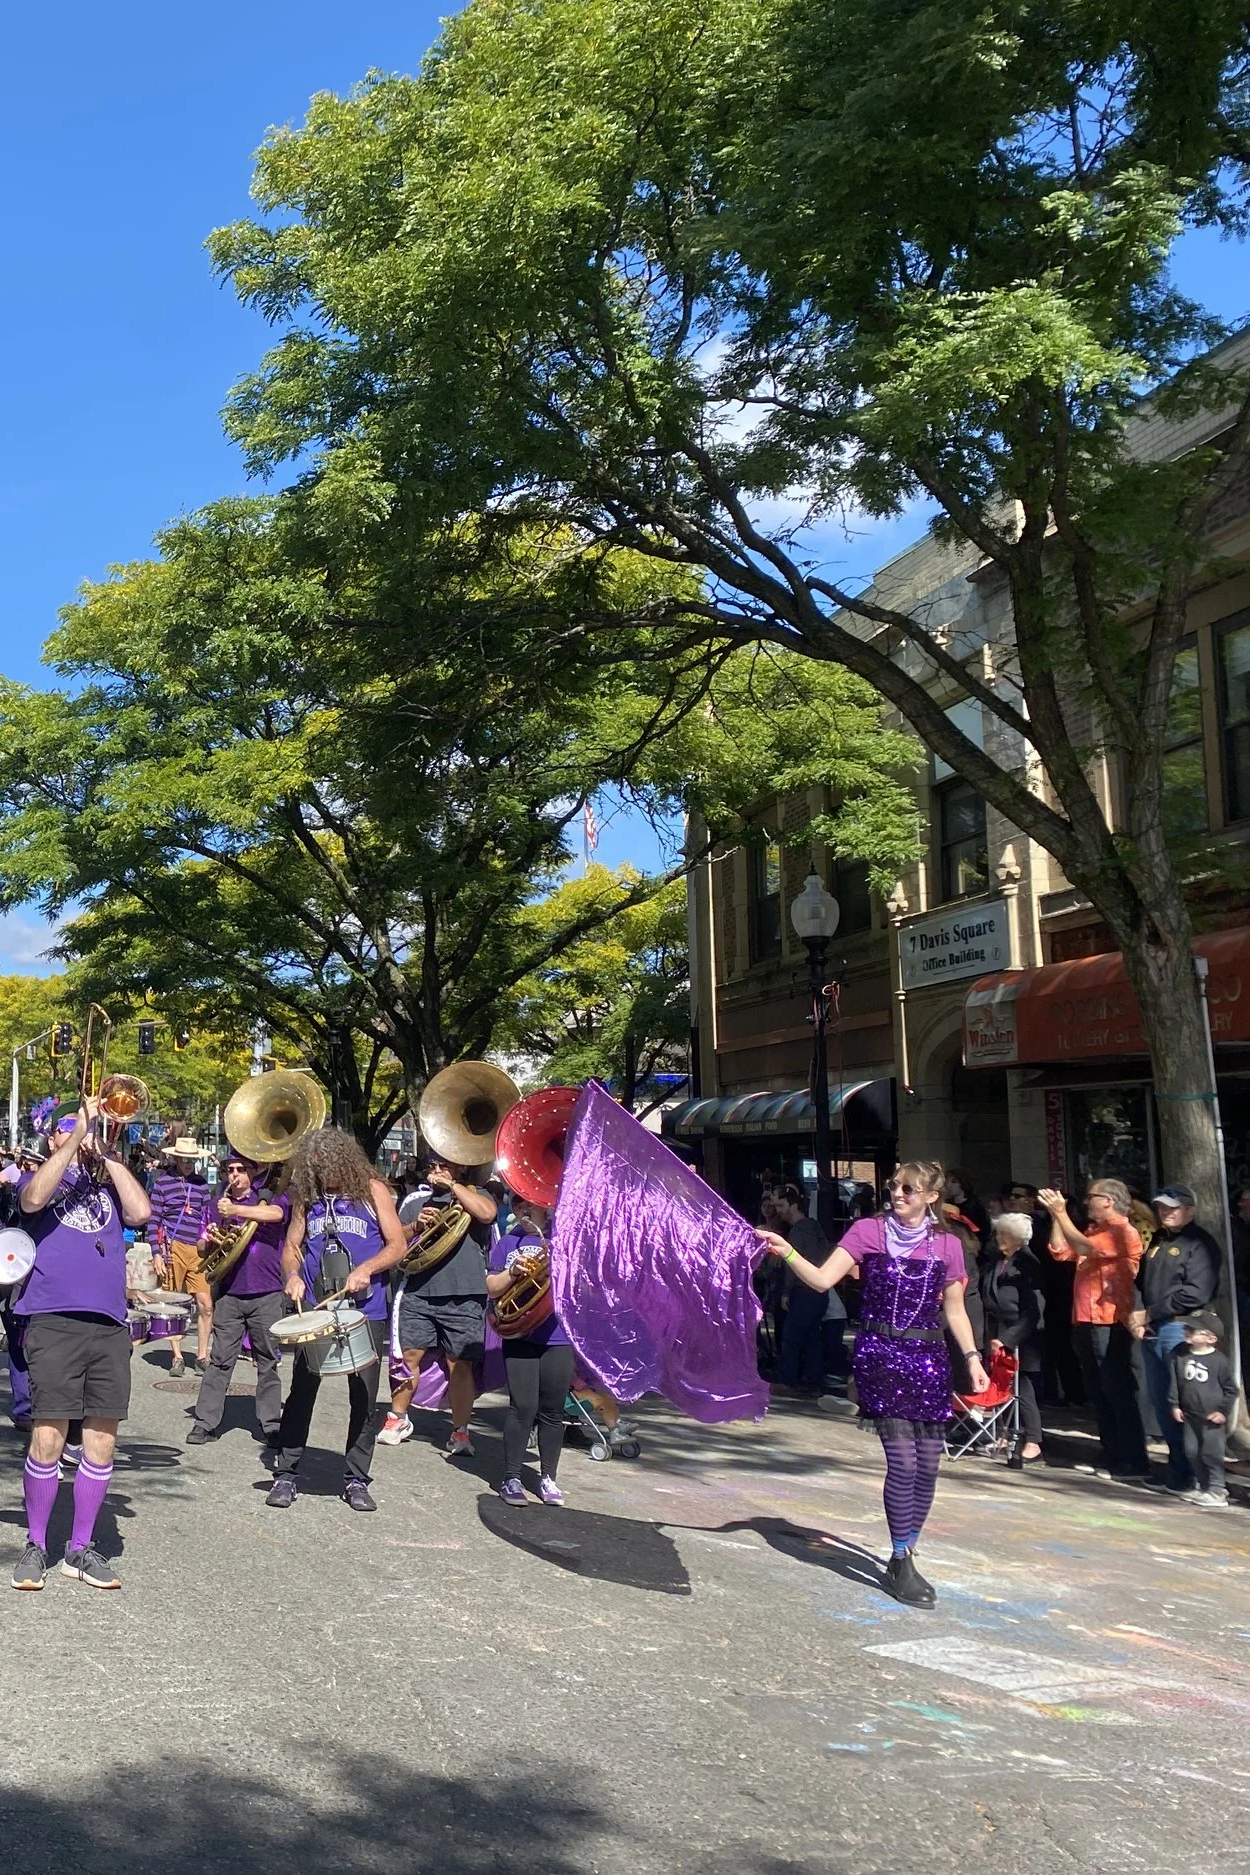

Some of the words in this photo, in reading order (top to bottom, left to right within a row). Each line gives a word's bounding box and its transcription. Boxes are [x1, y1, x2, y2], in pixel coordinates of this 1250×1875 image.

[910, 936, 916, 954] 7
[920, 929, 950, 951] Davis
[953, 920, 996, 944] Square
[922, 956, 947, 972] Office
[949, 948, 986, 967] Building
